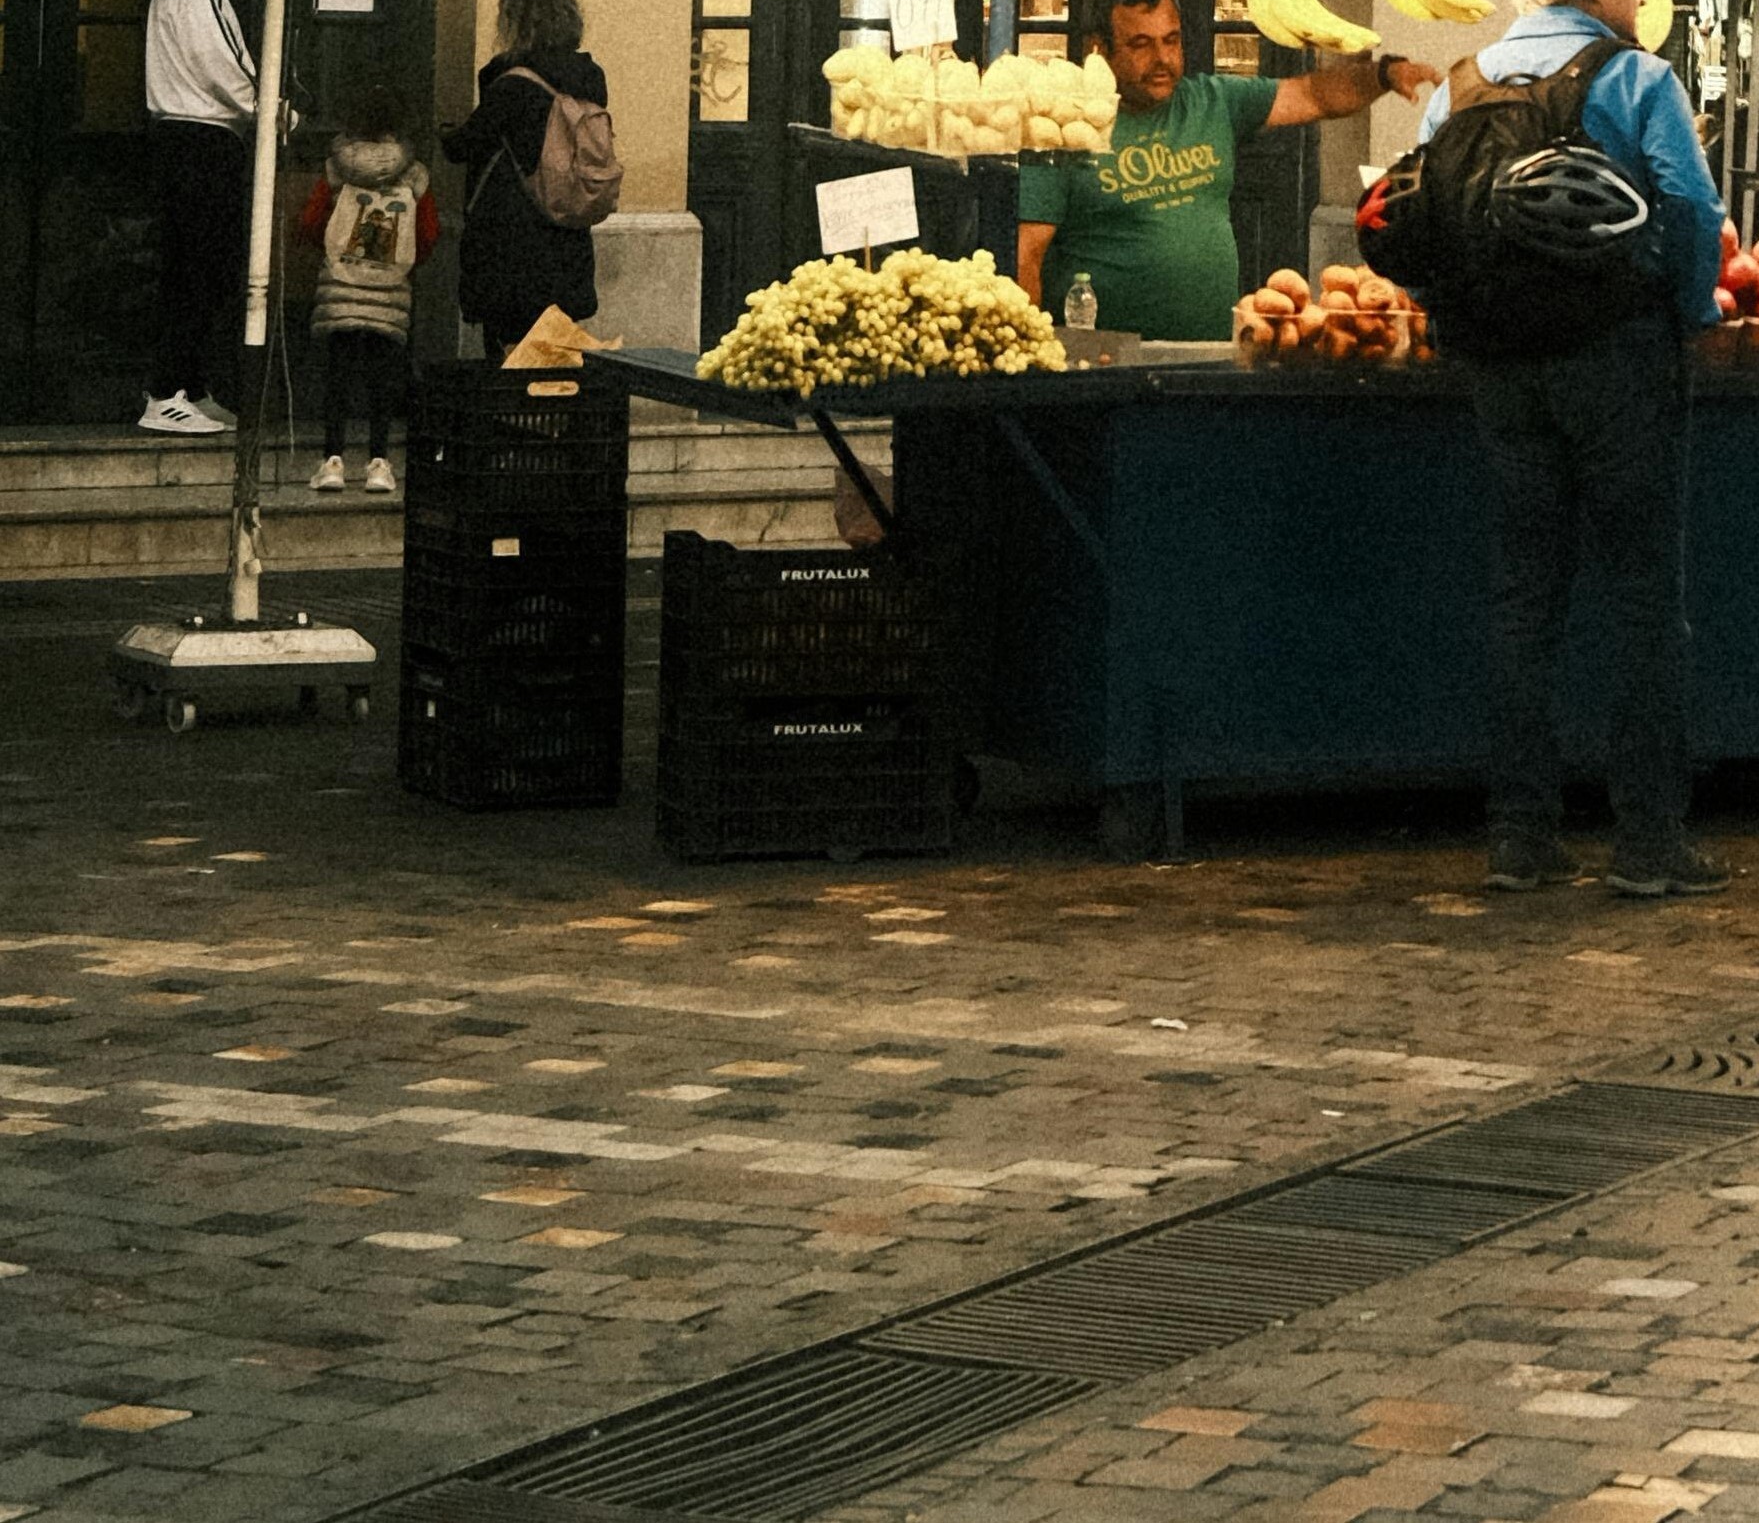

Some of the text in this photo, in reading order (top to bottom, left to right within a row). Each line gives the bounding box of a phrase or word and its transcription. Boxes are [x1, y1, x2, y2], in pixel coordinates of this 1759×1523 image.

[1098, 142, 1222, 194] s.Oliver
[780, 568, 870, 582] FRUTALUX
[773, 723, 863, 736] FRUTALUX
